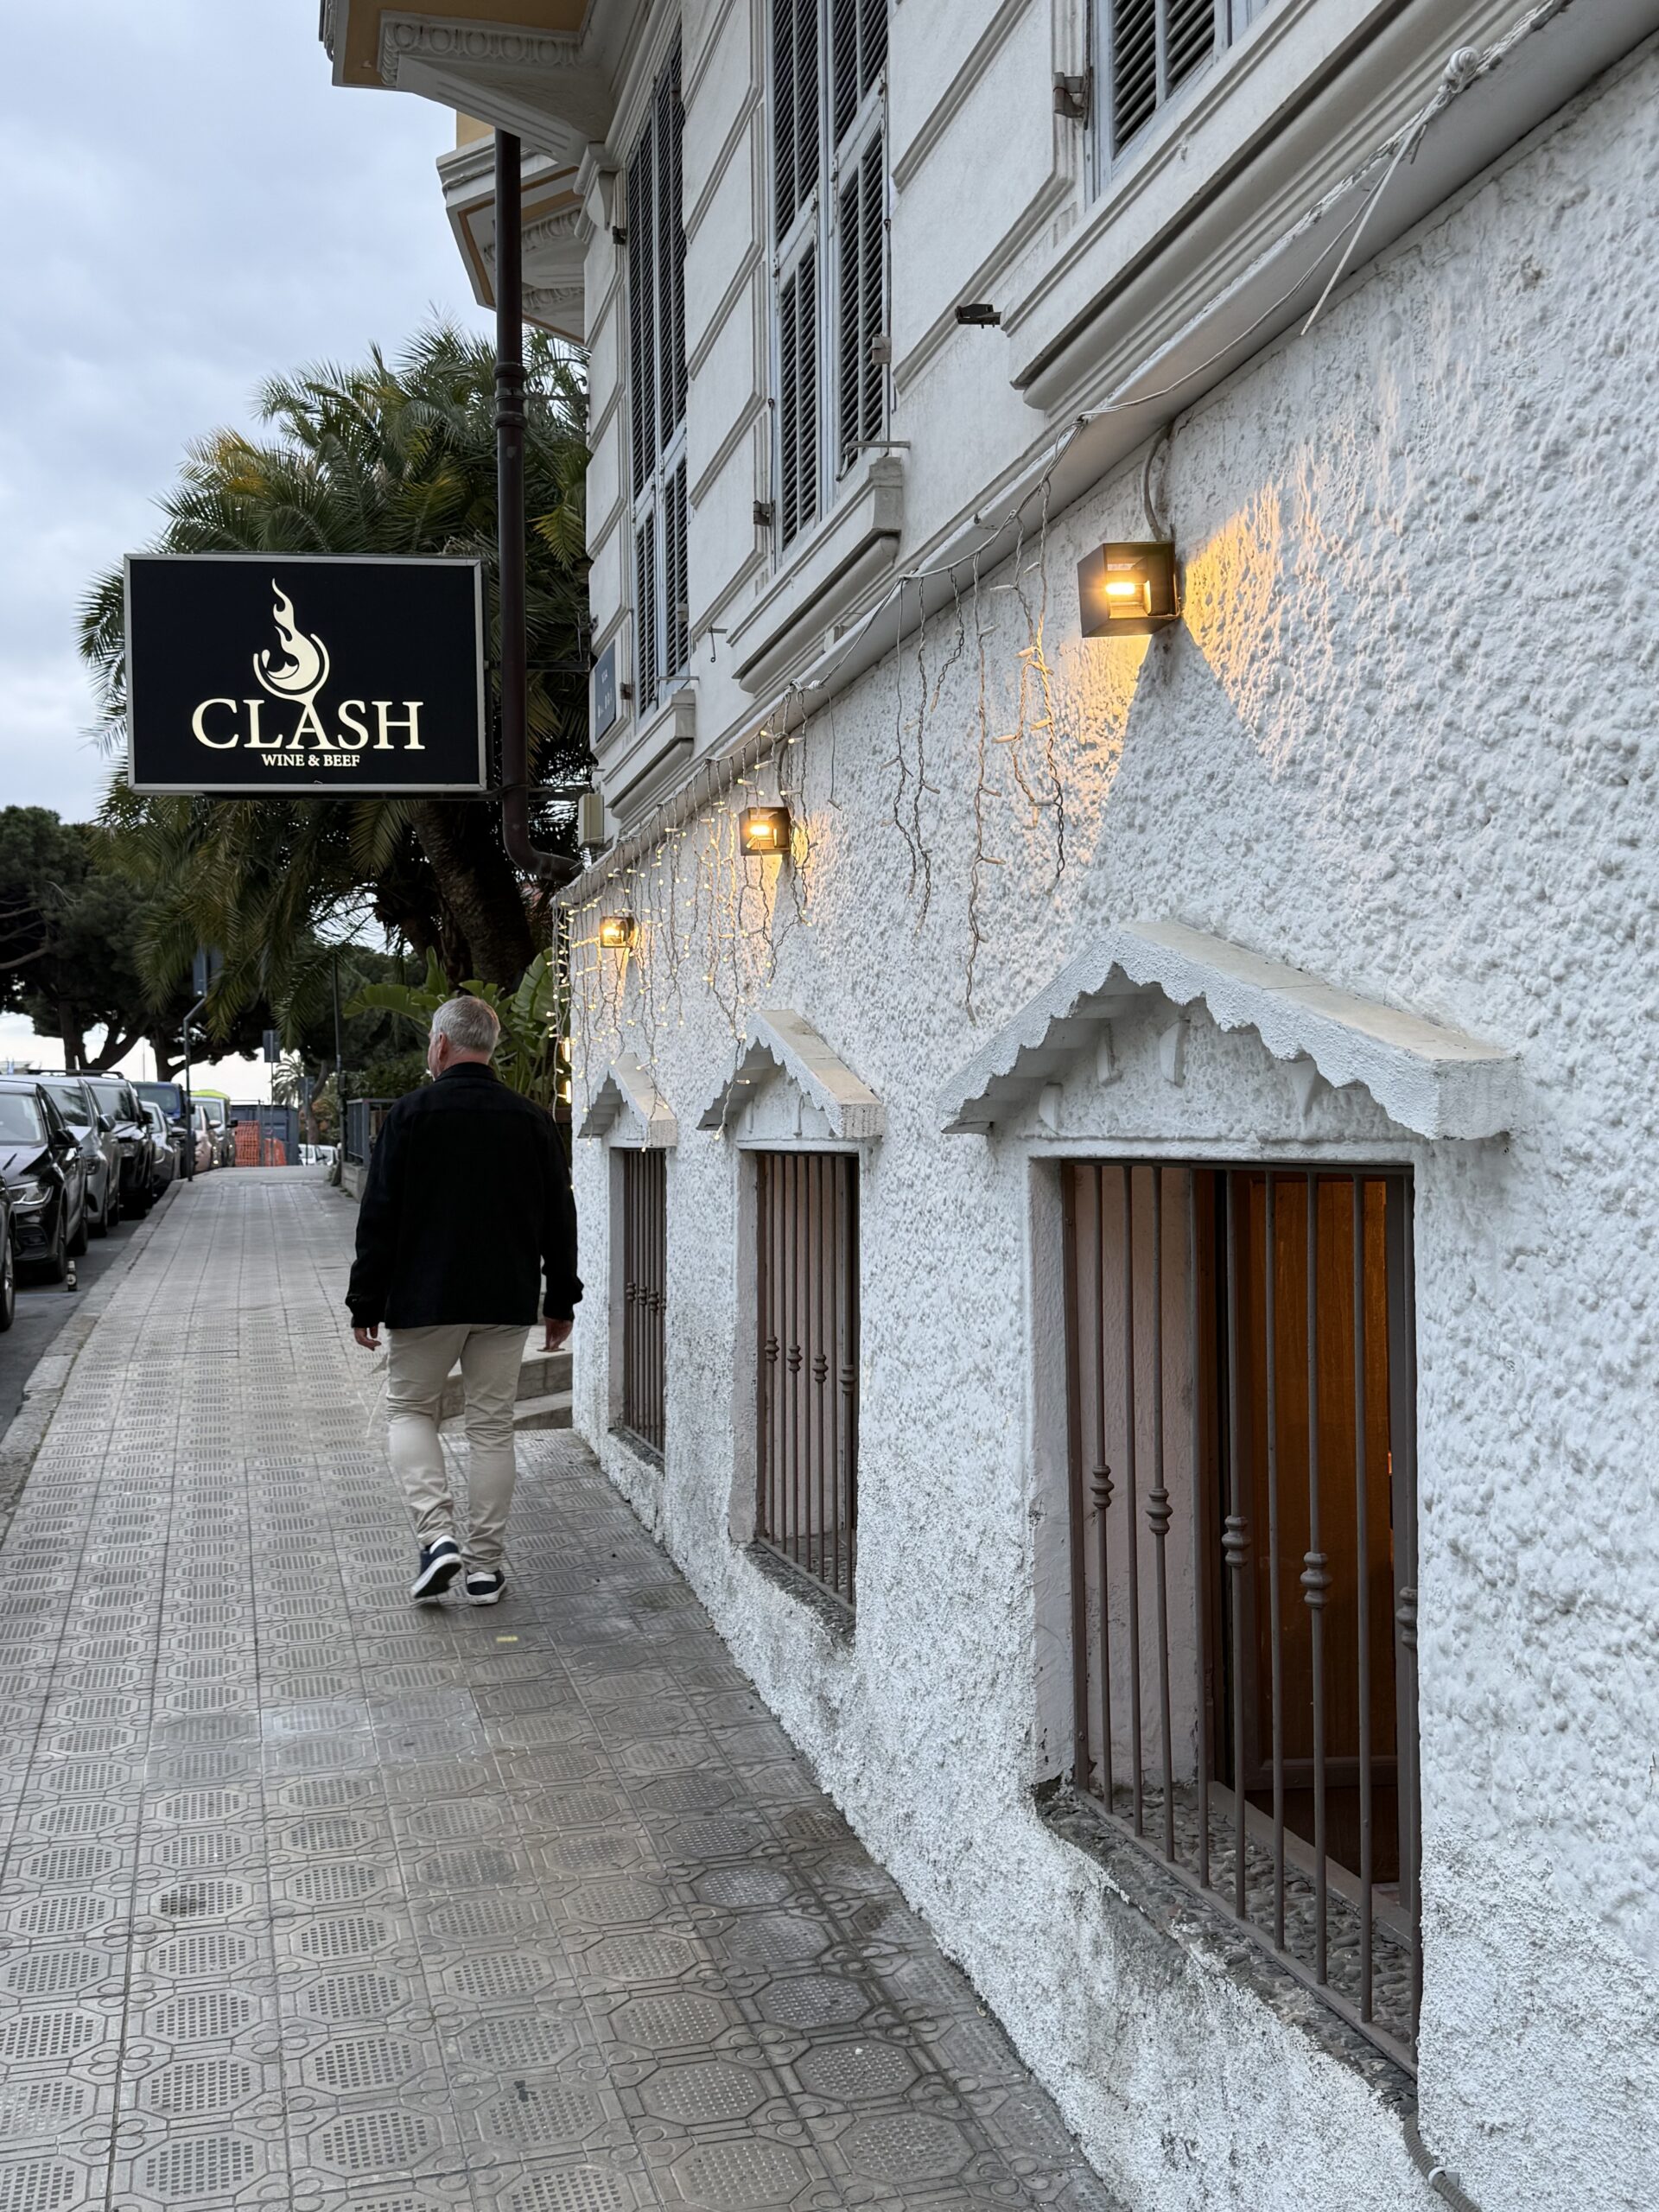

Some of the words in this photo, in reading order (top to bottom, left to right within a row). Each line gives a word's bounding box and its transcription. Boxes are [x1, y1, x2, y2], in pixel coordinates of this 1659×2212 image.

[191, 697, 426, 750] CLASH
[261, 753, 305, 766] WINE
[308, 754, 321, 767] &
[323, 754, 360, 767] BEEF
